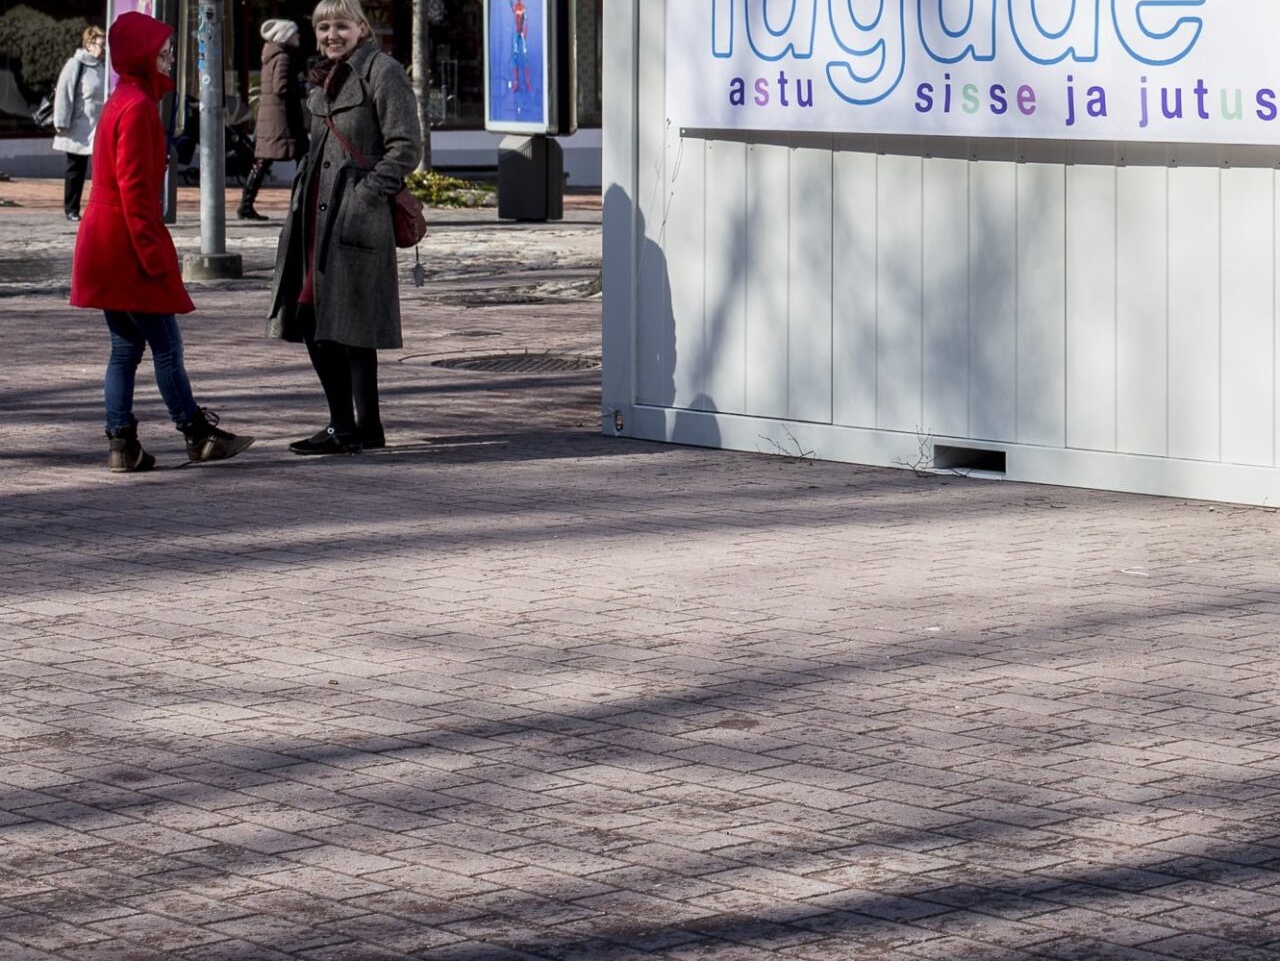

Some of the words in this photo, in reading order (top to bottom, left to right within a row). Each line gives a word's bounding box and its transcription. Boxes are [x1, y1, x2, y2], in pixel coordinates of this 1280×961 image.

[728, 69, 814, 109] astu
[914, 73, 1037, 116] sisse
[1065, 75, 1108, 127] ja
